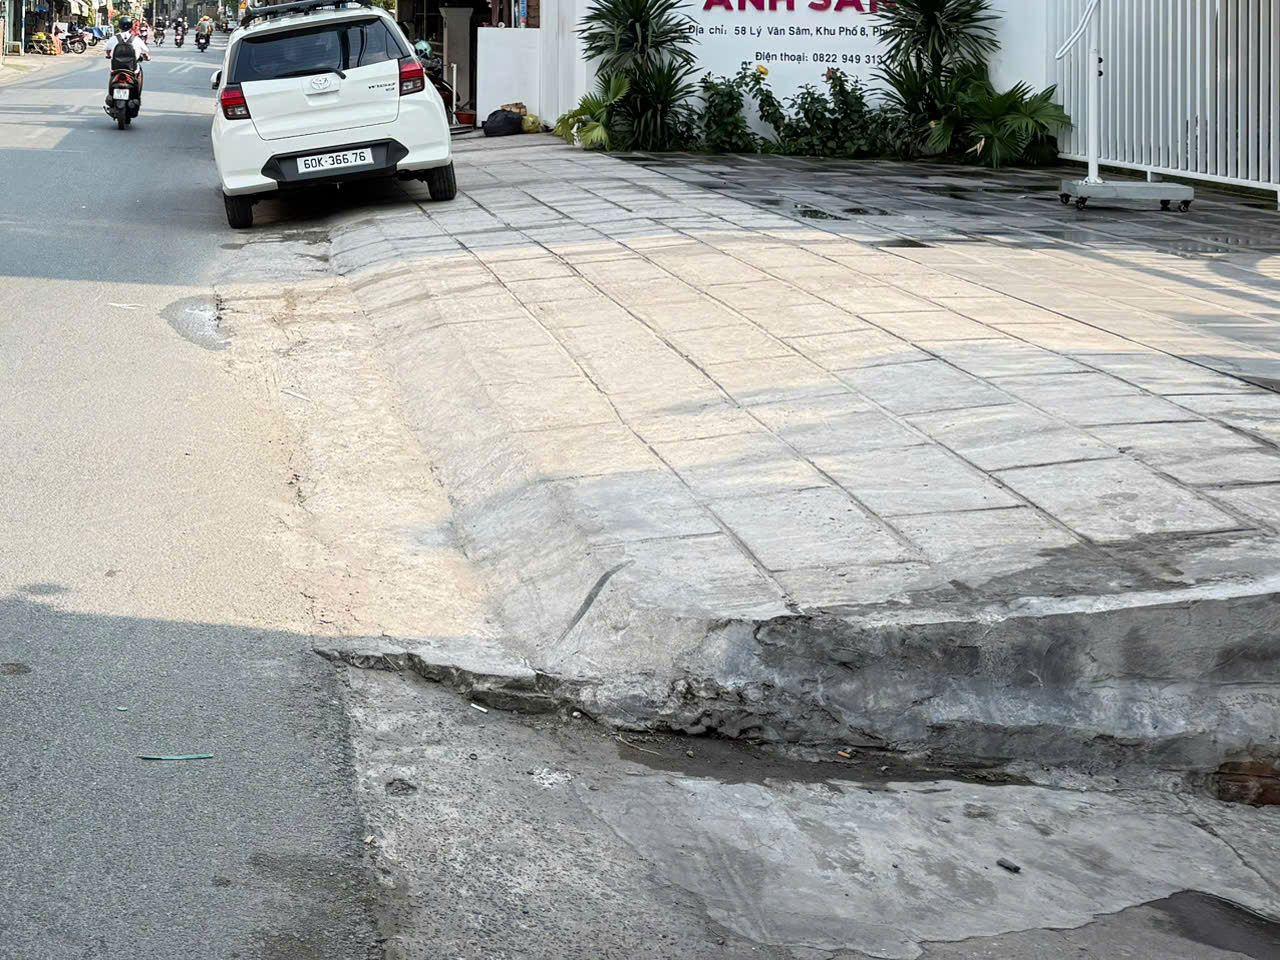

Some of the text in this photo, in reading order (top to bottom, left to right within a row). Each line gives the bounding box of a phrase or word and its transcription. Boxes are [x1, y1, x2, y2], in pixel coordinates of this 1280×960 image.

[688, 25, 704, 36] Địa
[709, 24, 727, 35] chỉ:
[734, 27, 747, 35] 58
[749, 25, 762, 37] Lý
[767, 25, 785, 36] Văn
[788, 26, 813, 37] Sâm,
[816, 26, 836, 36] Khu
[838, 25, 857, 36] Phố
[860, 26, 869, 38] 8,
[755, 51, 883, 65] Điện thoại: 0822 949 313
